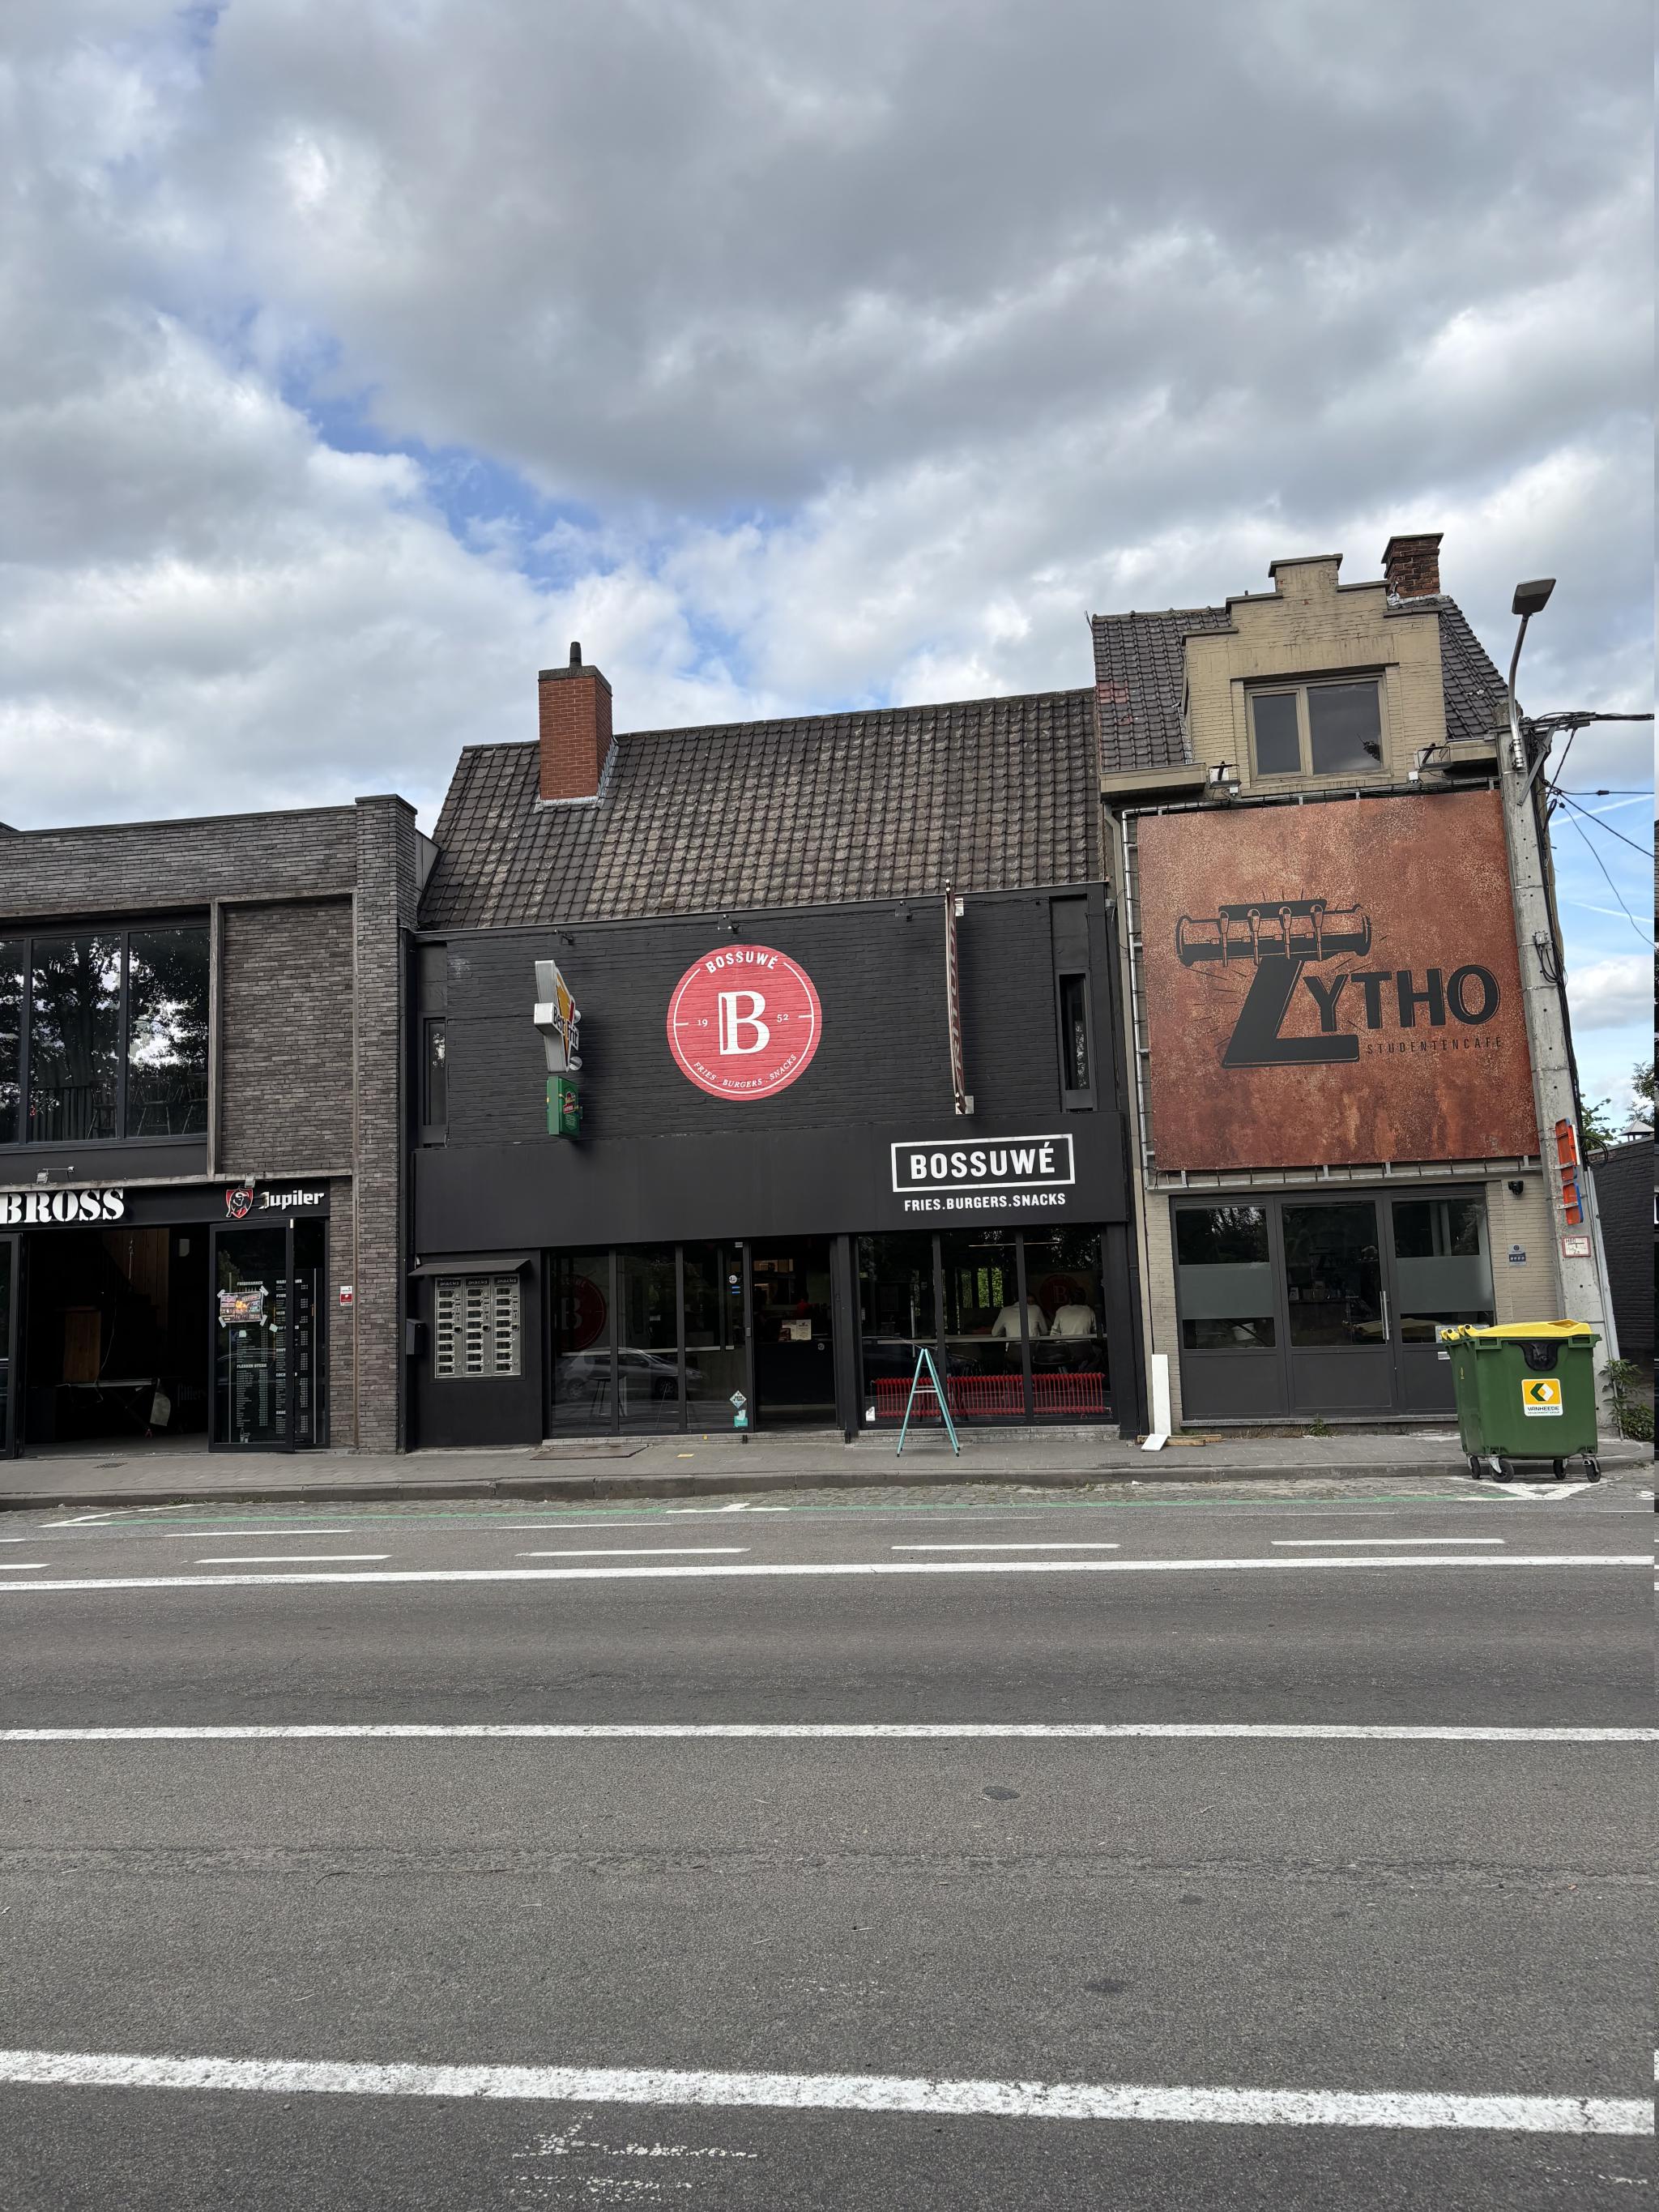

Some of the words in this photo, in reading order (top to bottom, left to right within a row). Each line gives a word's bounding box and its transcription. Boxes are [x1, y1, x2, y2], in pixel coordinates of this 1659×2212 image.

[705, 950, 778, 974] BOSSUWÉ
[697, 1019, 708, 1027] 19
[718, 990, 770, 1056] B
[776, 1014, 790, 1023] 52
[693, 1061, 718, 1081] FRIES
[722, 1078, 762, 1088] BURGERS
[770, 1053, 797, 1080] SNACKS
[910, 1141, 1055, 1180] BOSSUWÉ
[0, 1188, 125, 1224] BROSS
[258, 1189, 325, 1210] Jupiler
